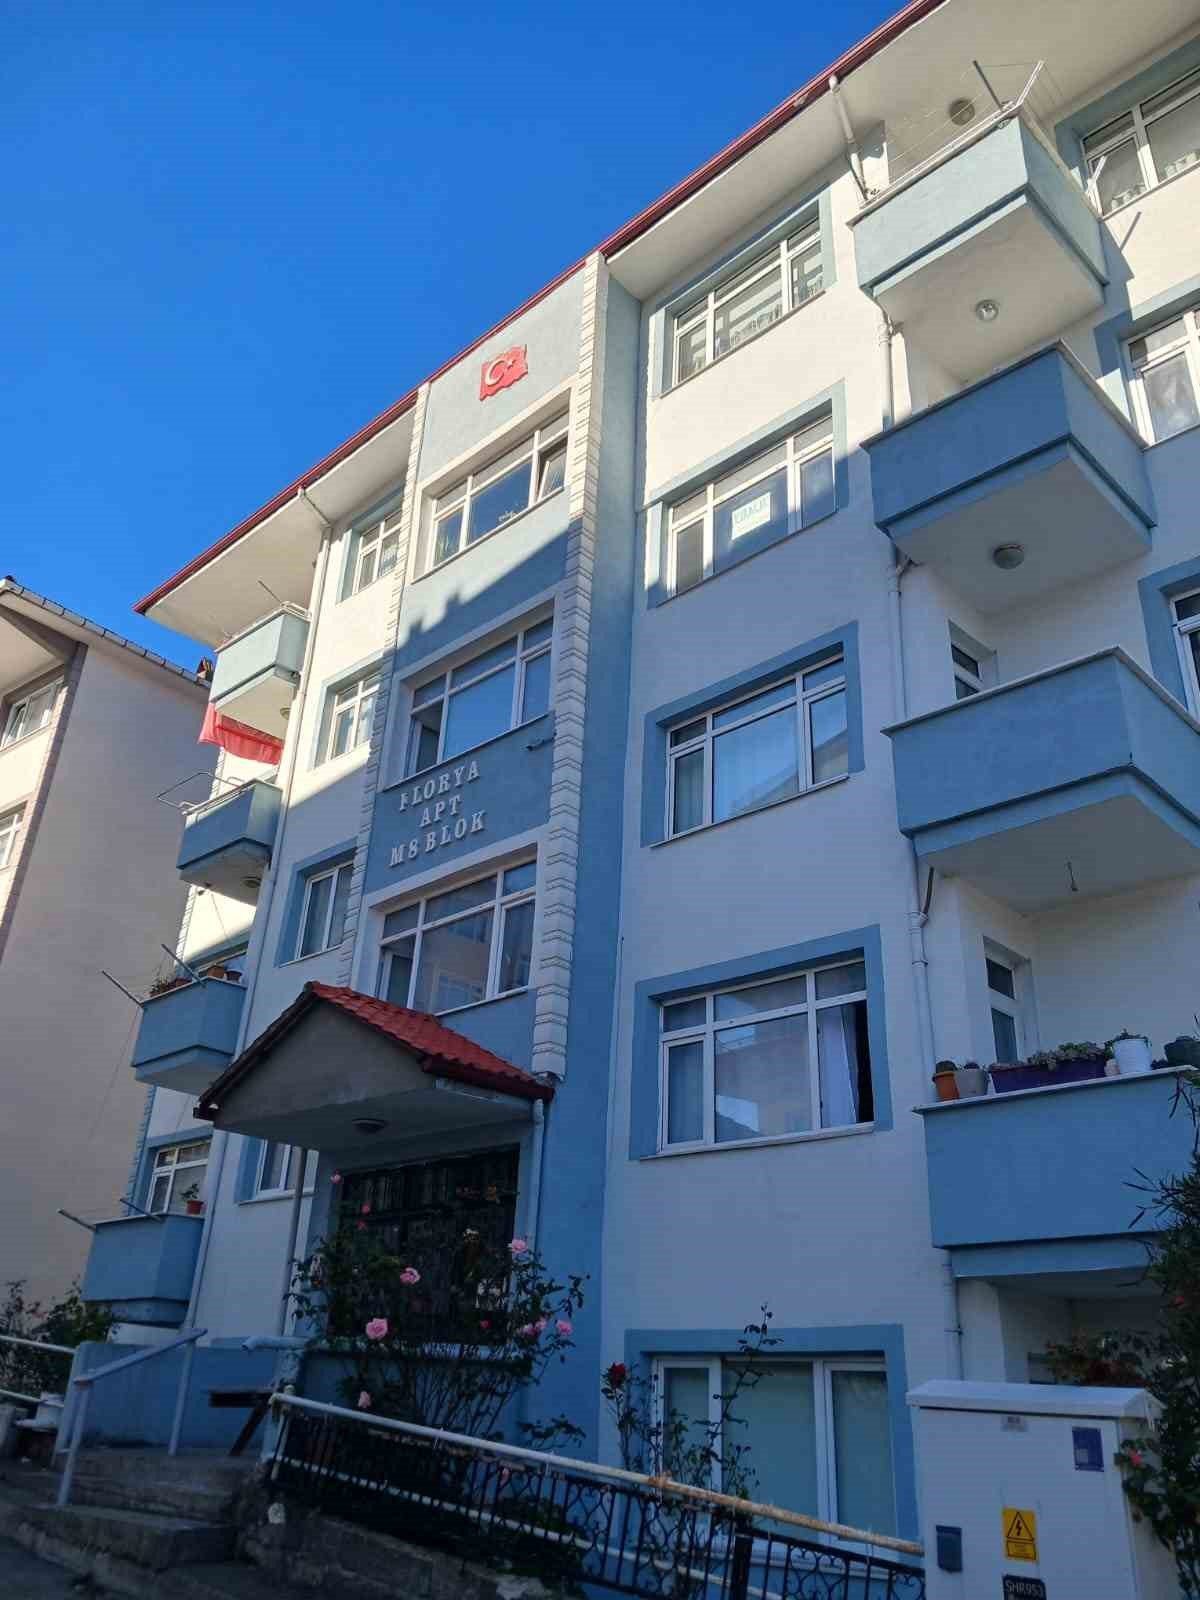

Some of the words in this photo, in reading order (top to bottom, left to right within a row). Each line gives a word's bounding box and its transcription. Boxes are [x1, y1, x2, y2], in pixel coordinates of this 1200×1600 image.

[400, 760, 480, 811] FLORYA
[420, 794, 461, 828] APT
[425, 809, 486, 853] BLOK
